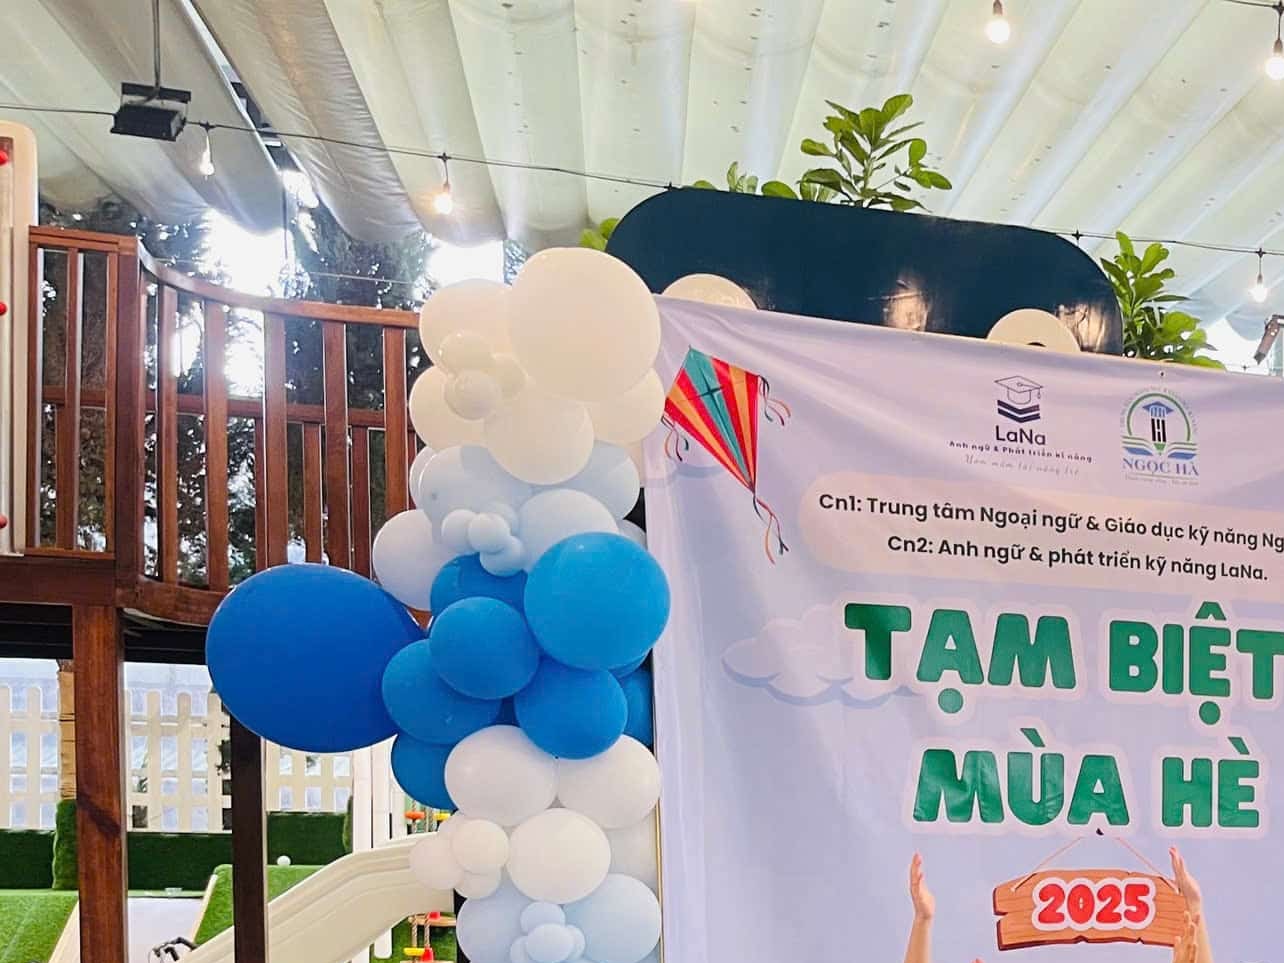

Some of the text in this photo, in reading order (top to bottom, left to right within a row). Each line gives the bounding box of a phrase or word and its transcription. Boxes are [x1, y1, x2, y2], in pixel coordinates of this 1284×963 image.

[995, 425, 1047, 446] LaNa
[1122, 457, 1199, 476] NGỌC HÀ
[819, 494, 862, 512] Cn1:
[867, 497, 928, 522] Trung
[933, 502, 975, 521] tâm
[980, 506, 1037, 529] Ngoại
[1042, 513, 1082, 533] ngữ
[1086, 516, 1100, 531] &
[1105, 517, 1147, 535] Giáo
[1151, 521, 1185, 542] dục
[1189, 525, 1209, 546] kỹ
[1213, 527, 1258, 549] năng
[888, 536, 1268, 581] Cn2: Anh ngữ & phát triển kỹ năng LaNa.
[844, 602, 1077, 714] TẠM
[912, 727, 1260, 828] MÙA HÈ
[1038, 883, 1150, 925] 2025
